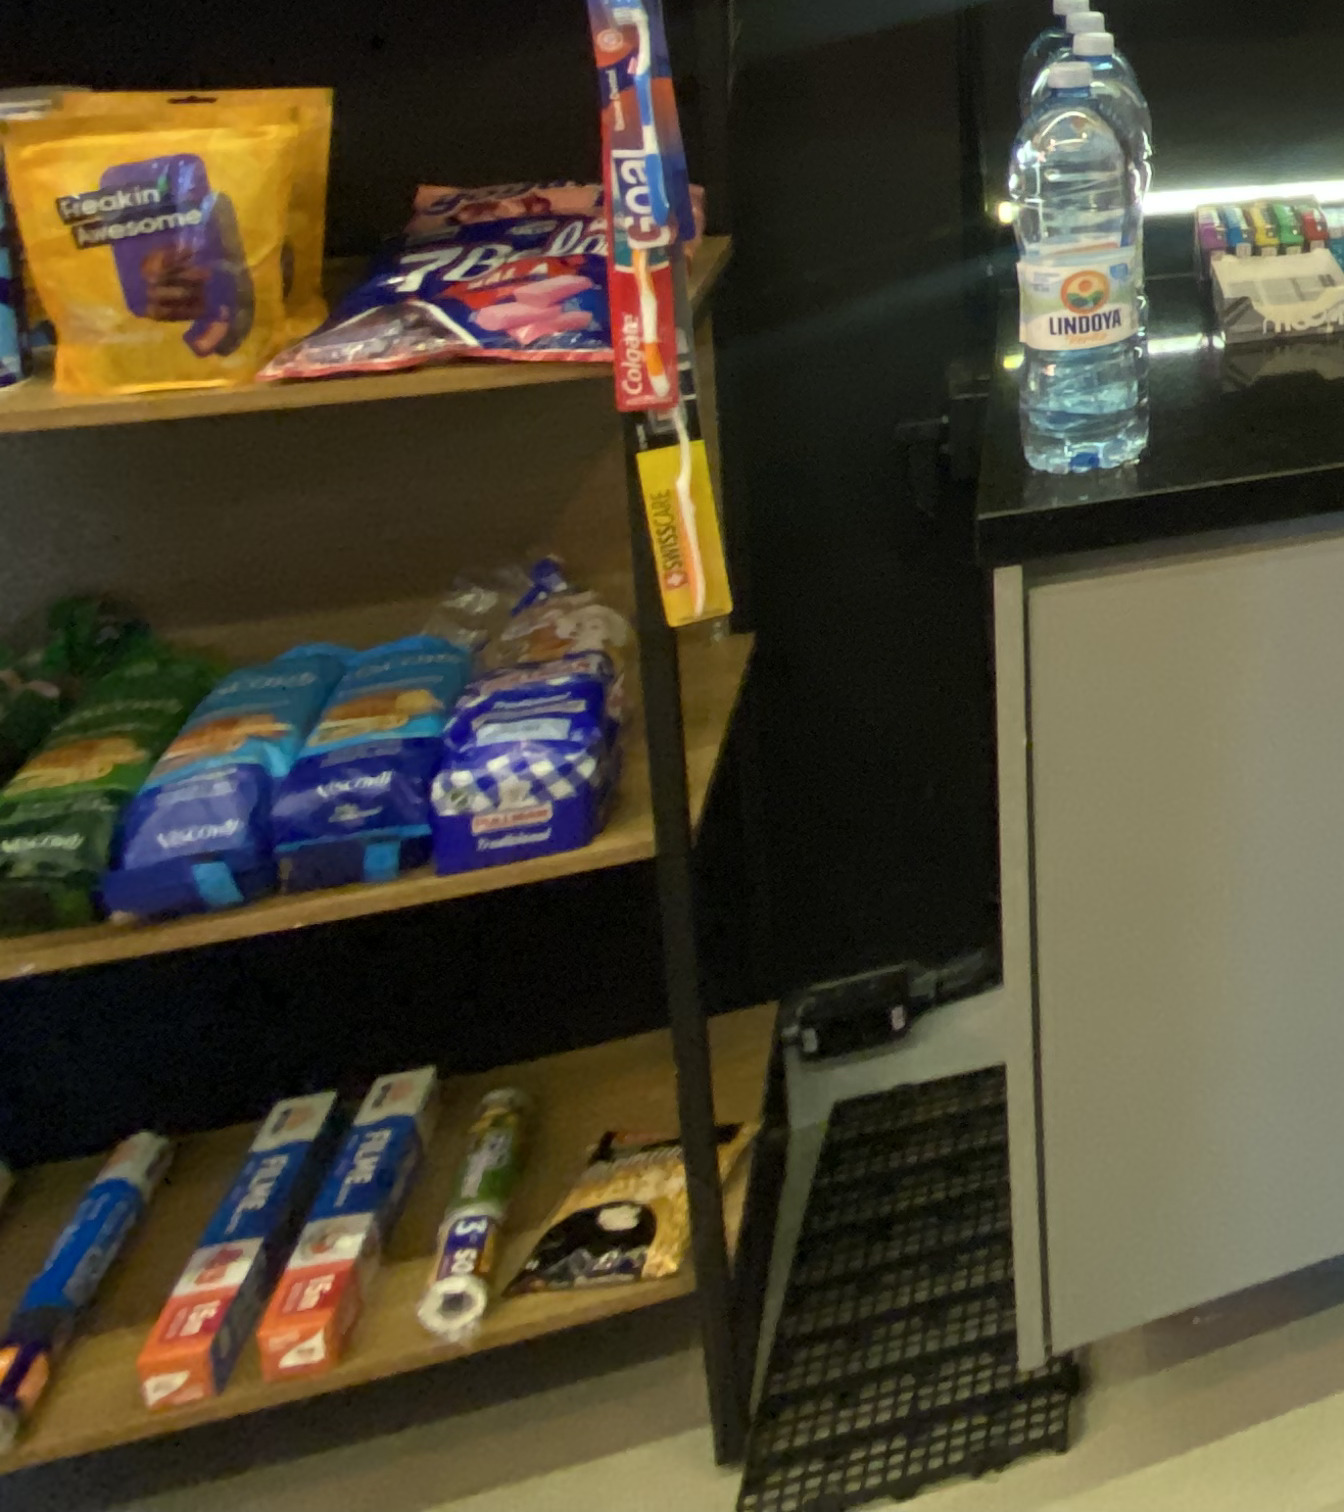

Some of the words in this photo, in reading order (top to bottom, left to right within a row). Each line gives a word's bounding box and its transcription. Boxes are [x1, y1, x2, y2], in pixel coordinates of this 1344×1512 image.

[60, 184, 163, 221] Freakin
[75, 205, 203, 245] Awesome
[395, 247, 463, 293] 7
[1049, 308, 1122, 336] LINDOYA
[618, 313, 643, 397] Colgate
[649, 488, 687, 572] SWISSCARE
